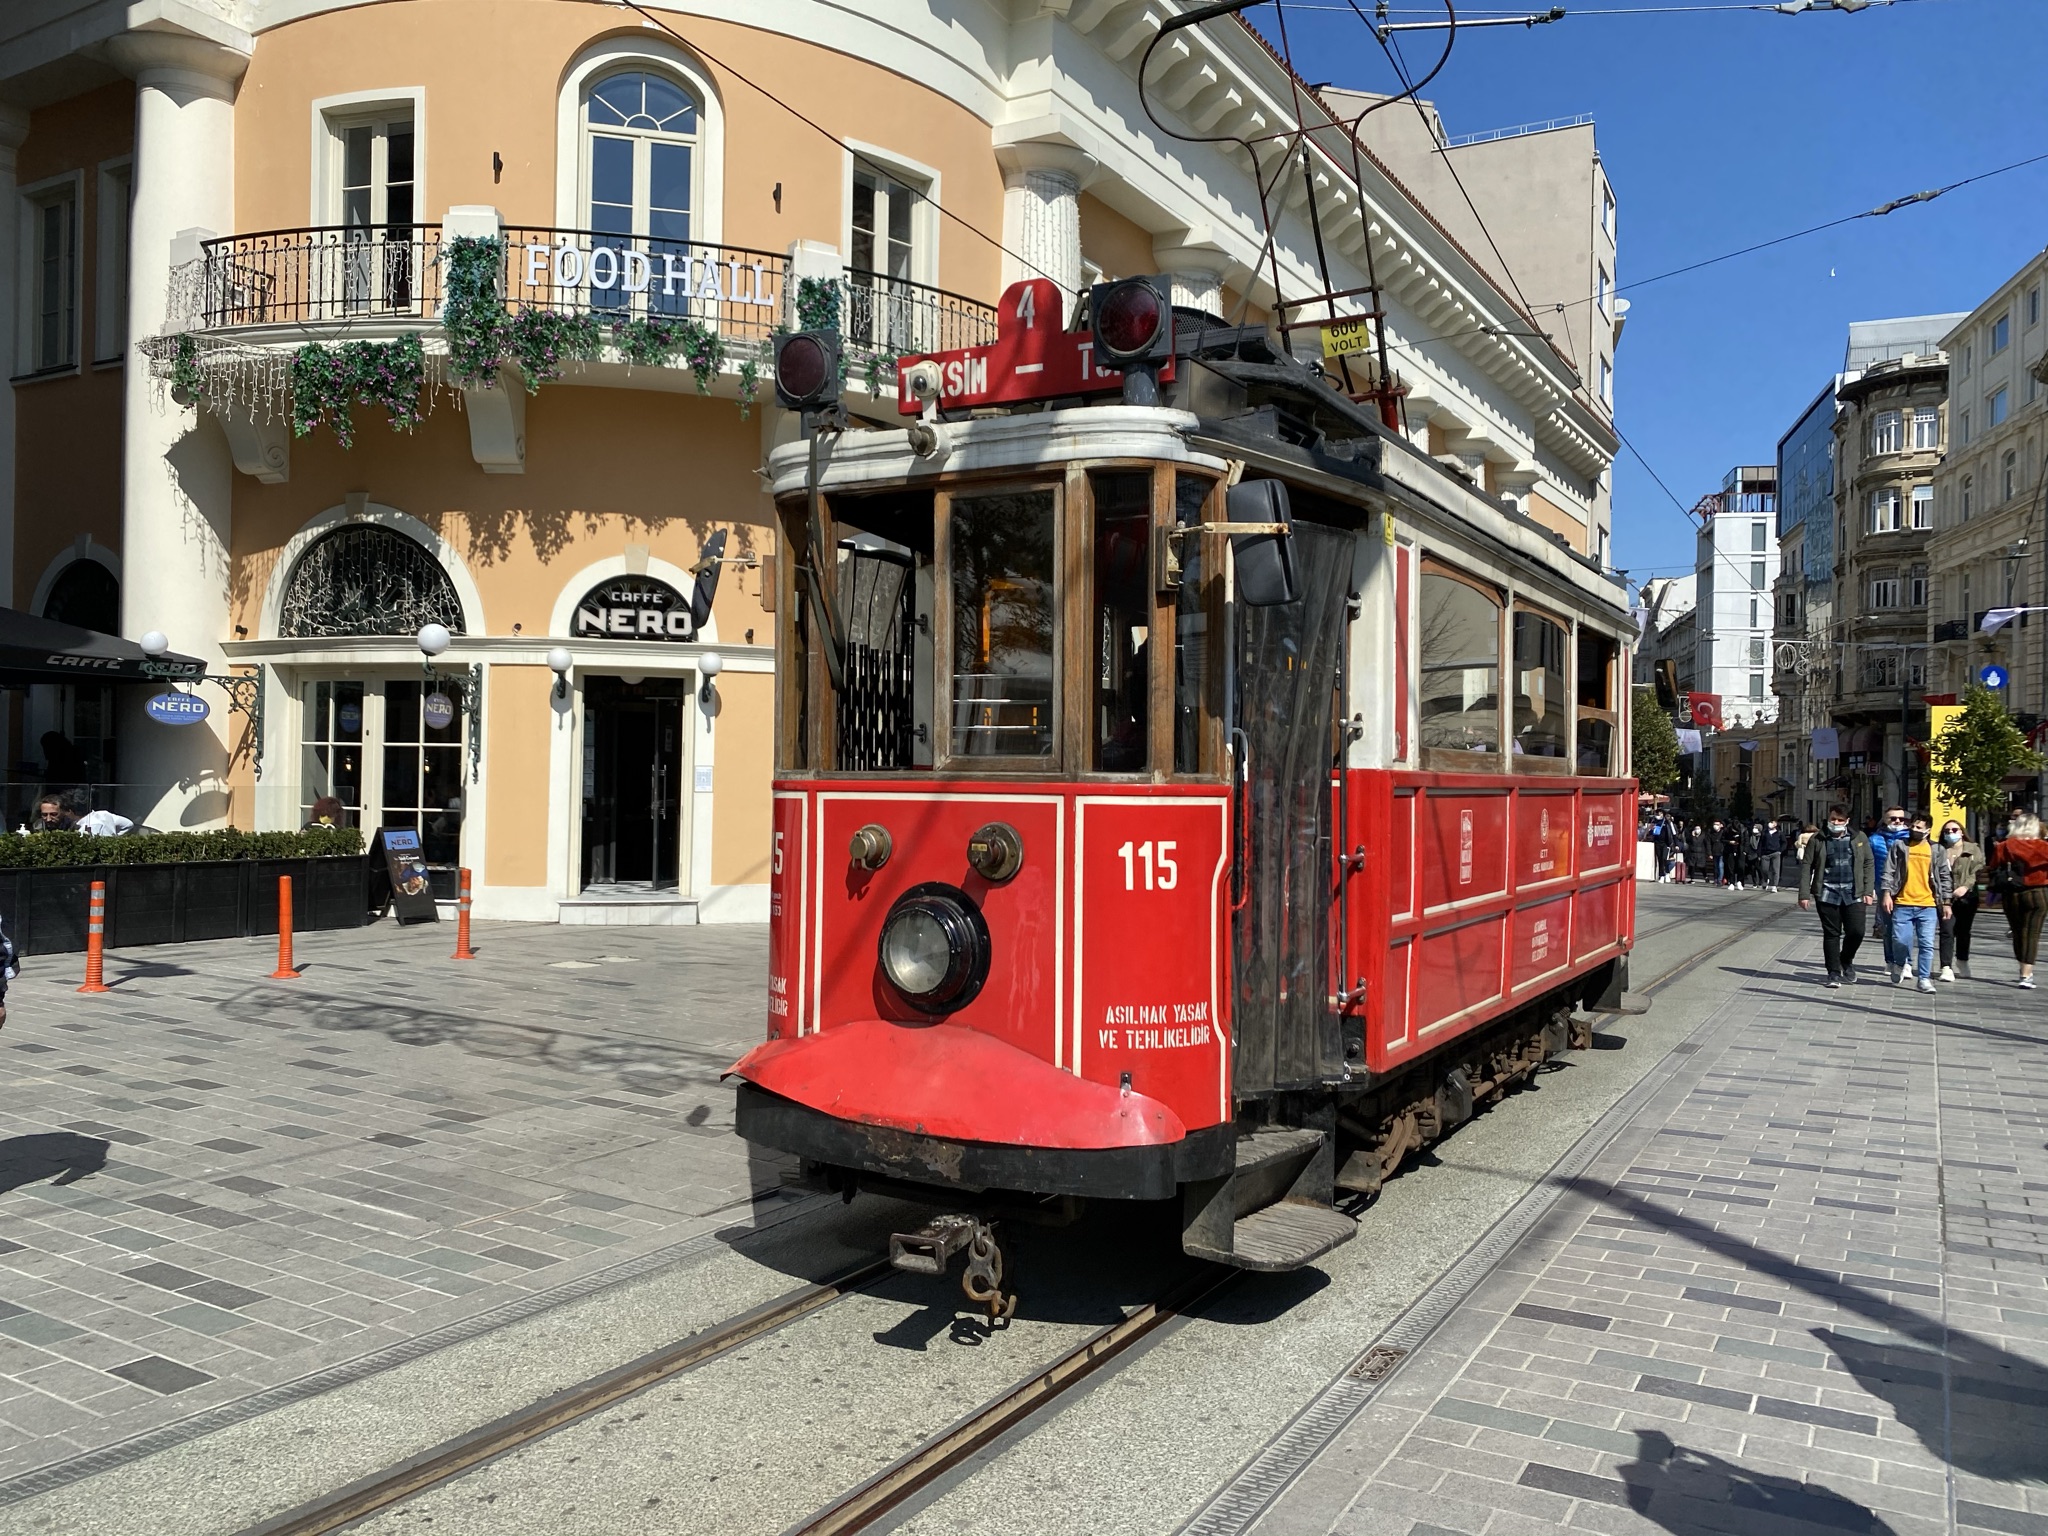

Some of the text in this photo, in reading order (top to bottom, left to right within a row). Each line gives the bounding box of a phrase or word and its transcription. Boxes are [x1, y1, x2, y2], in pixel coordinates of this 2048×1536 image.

[525, 244, 774, 307] FOOD HALL
[1016, 285, 1035, 329] 4
[1330, 321, 1358, 338] 600
[1330, 336, 1363, 352] VOLT
[901, 352, 988, 403] TSİM
[578, 607, 693, 636] NERO
[152, 701, 204, 713] NERO
[426, 703, 452, 715] NERO
[391, 838, 413, 846] NERO
[1117, 841, 1178, 891] 115
[1105, 1001, 1208, 1025] ASILMAK YASAK
[1098, 1023, 1211, 1050] VE TEHLİKELİDİR
